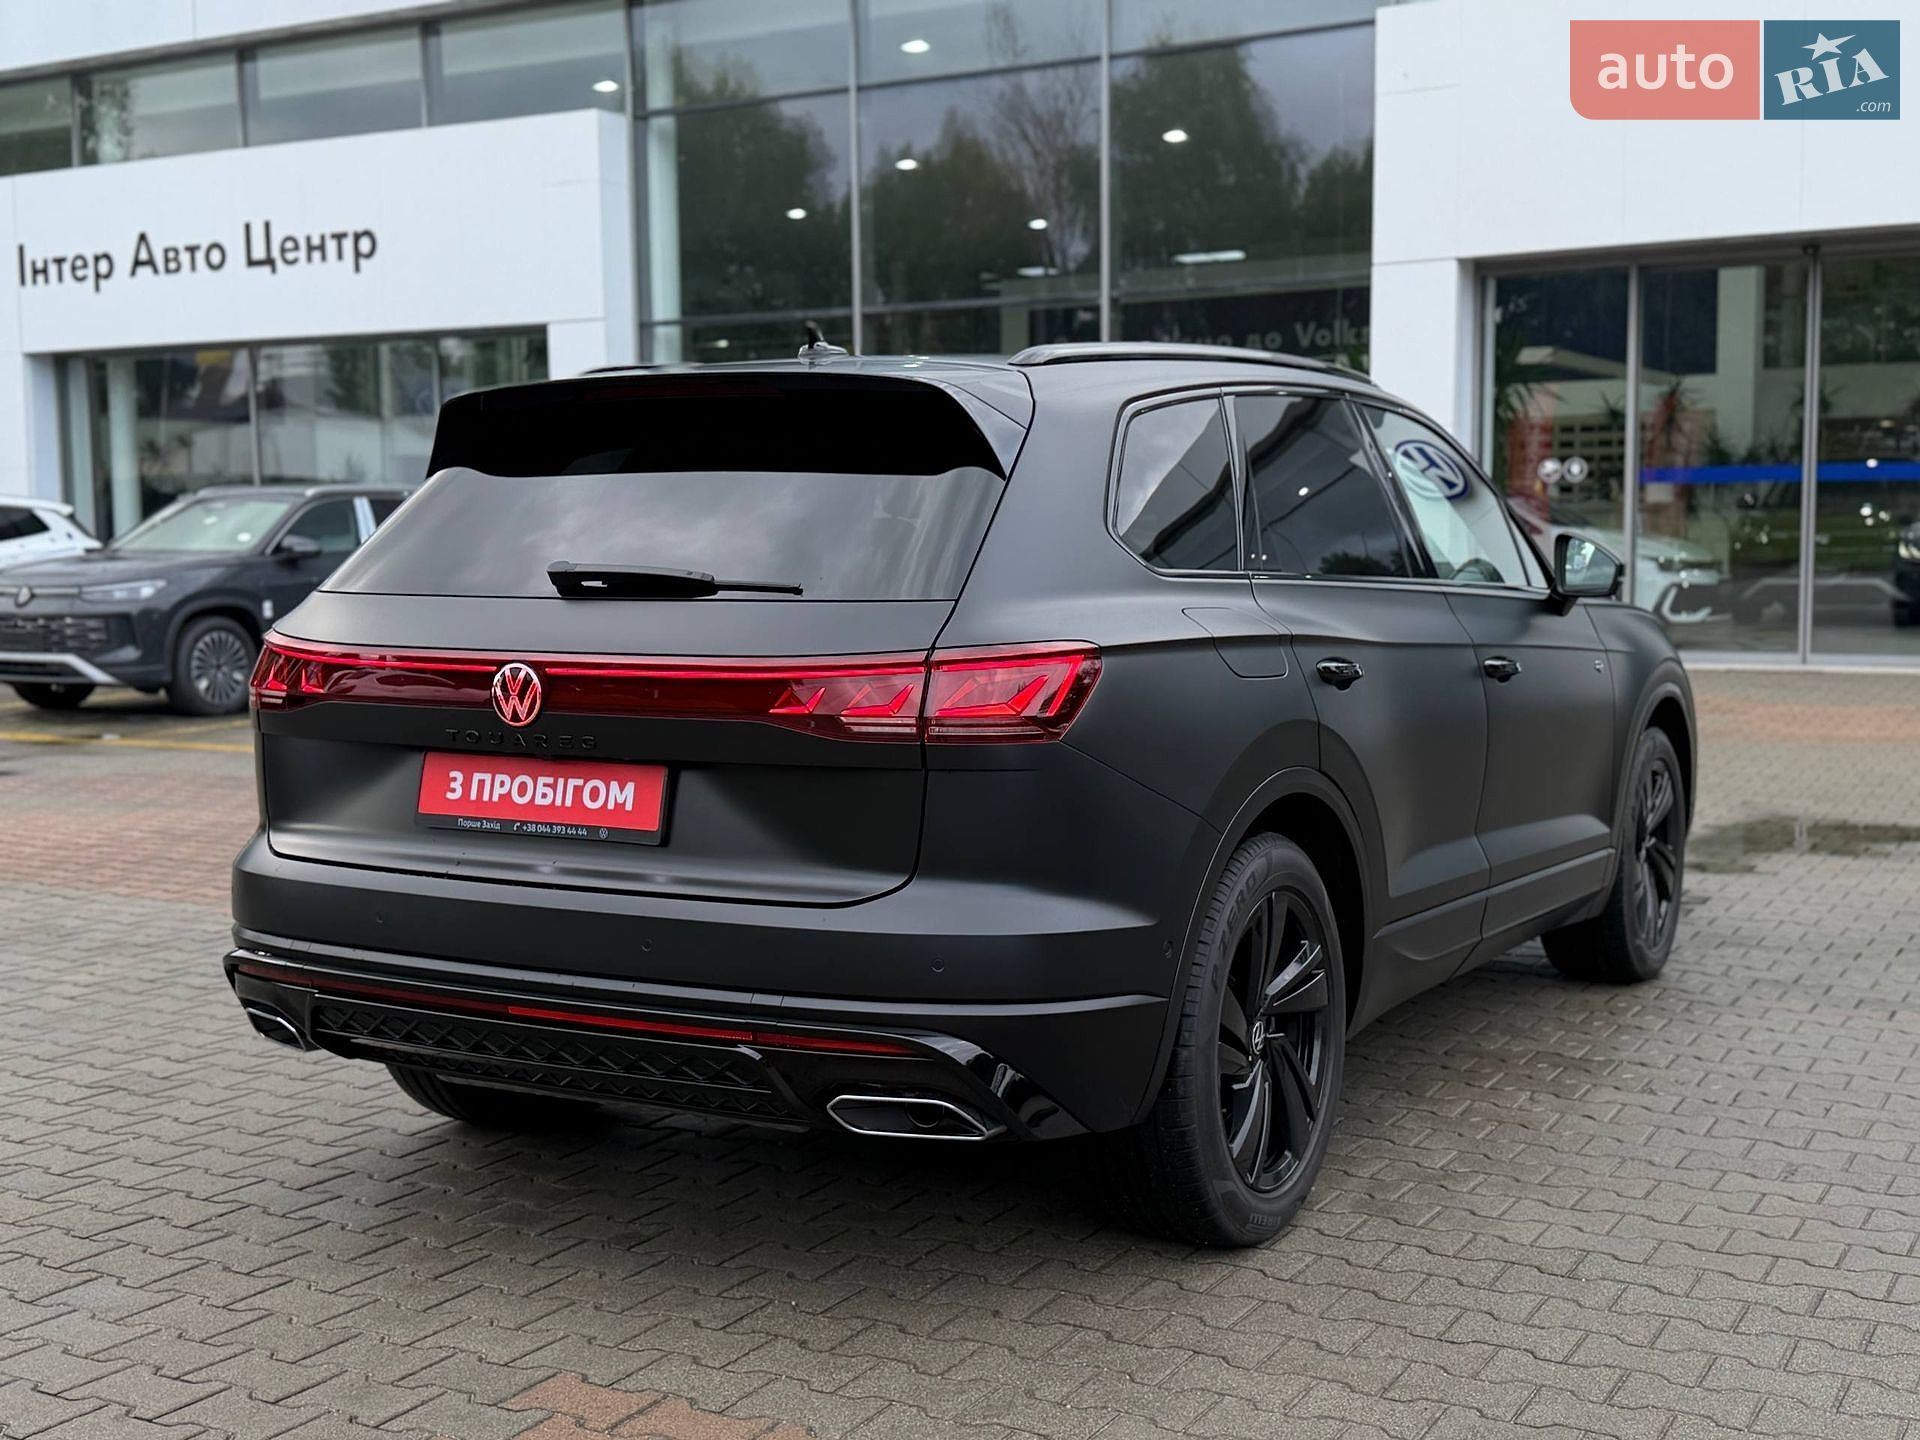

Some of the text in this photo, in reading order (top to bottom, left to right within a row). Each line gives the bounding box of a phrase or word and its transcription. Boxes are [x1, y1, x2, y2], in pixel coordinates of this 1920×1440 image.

[17, 220, 378, 294] Інтер Авто Центр
[469, 772, 636, 812] ПРОБІГОМ
[457, 818, 501, 830] Порше Захід
[522, 823, 588, 837] +38 044 393 44 44
